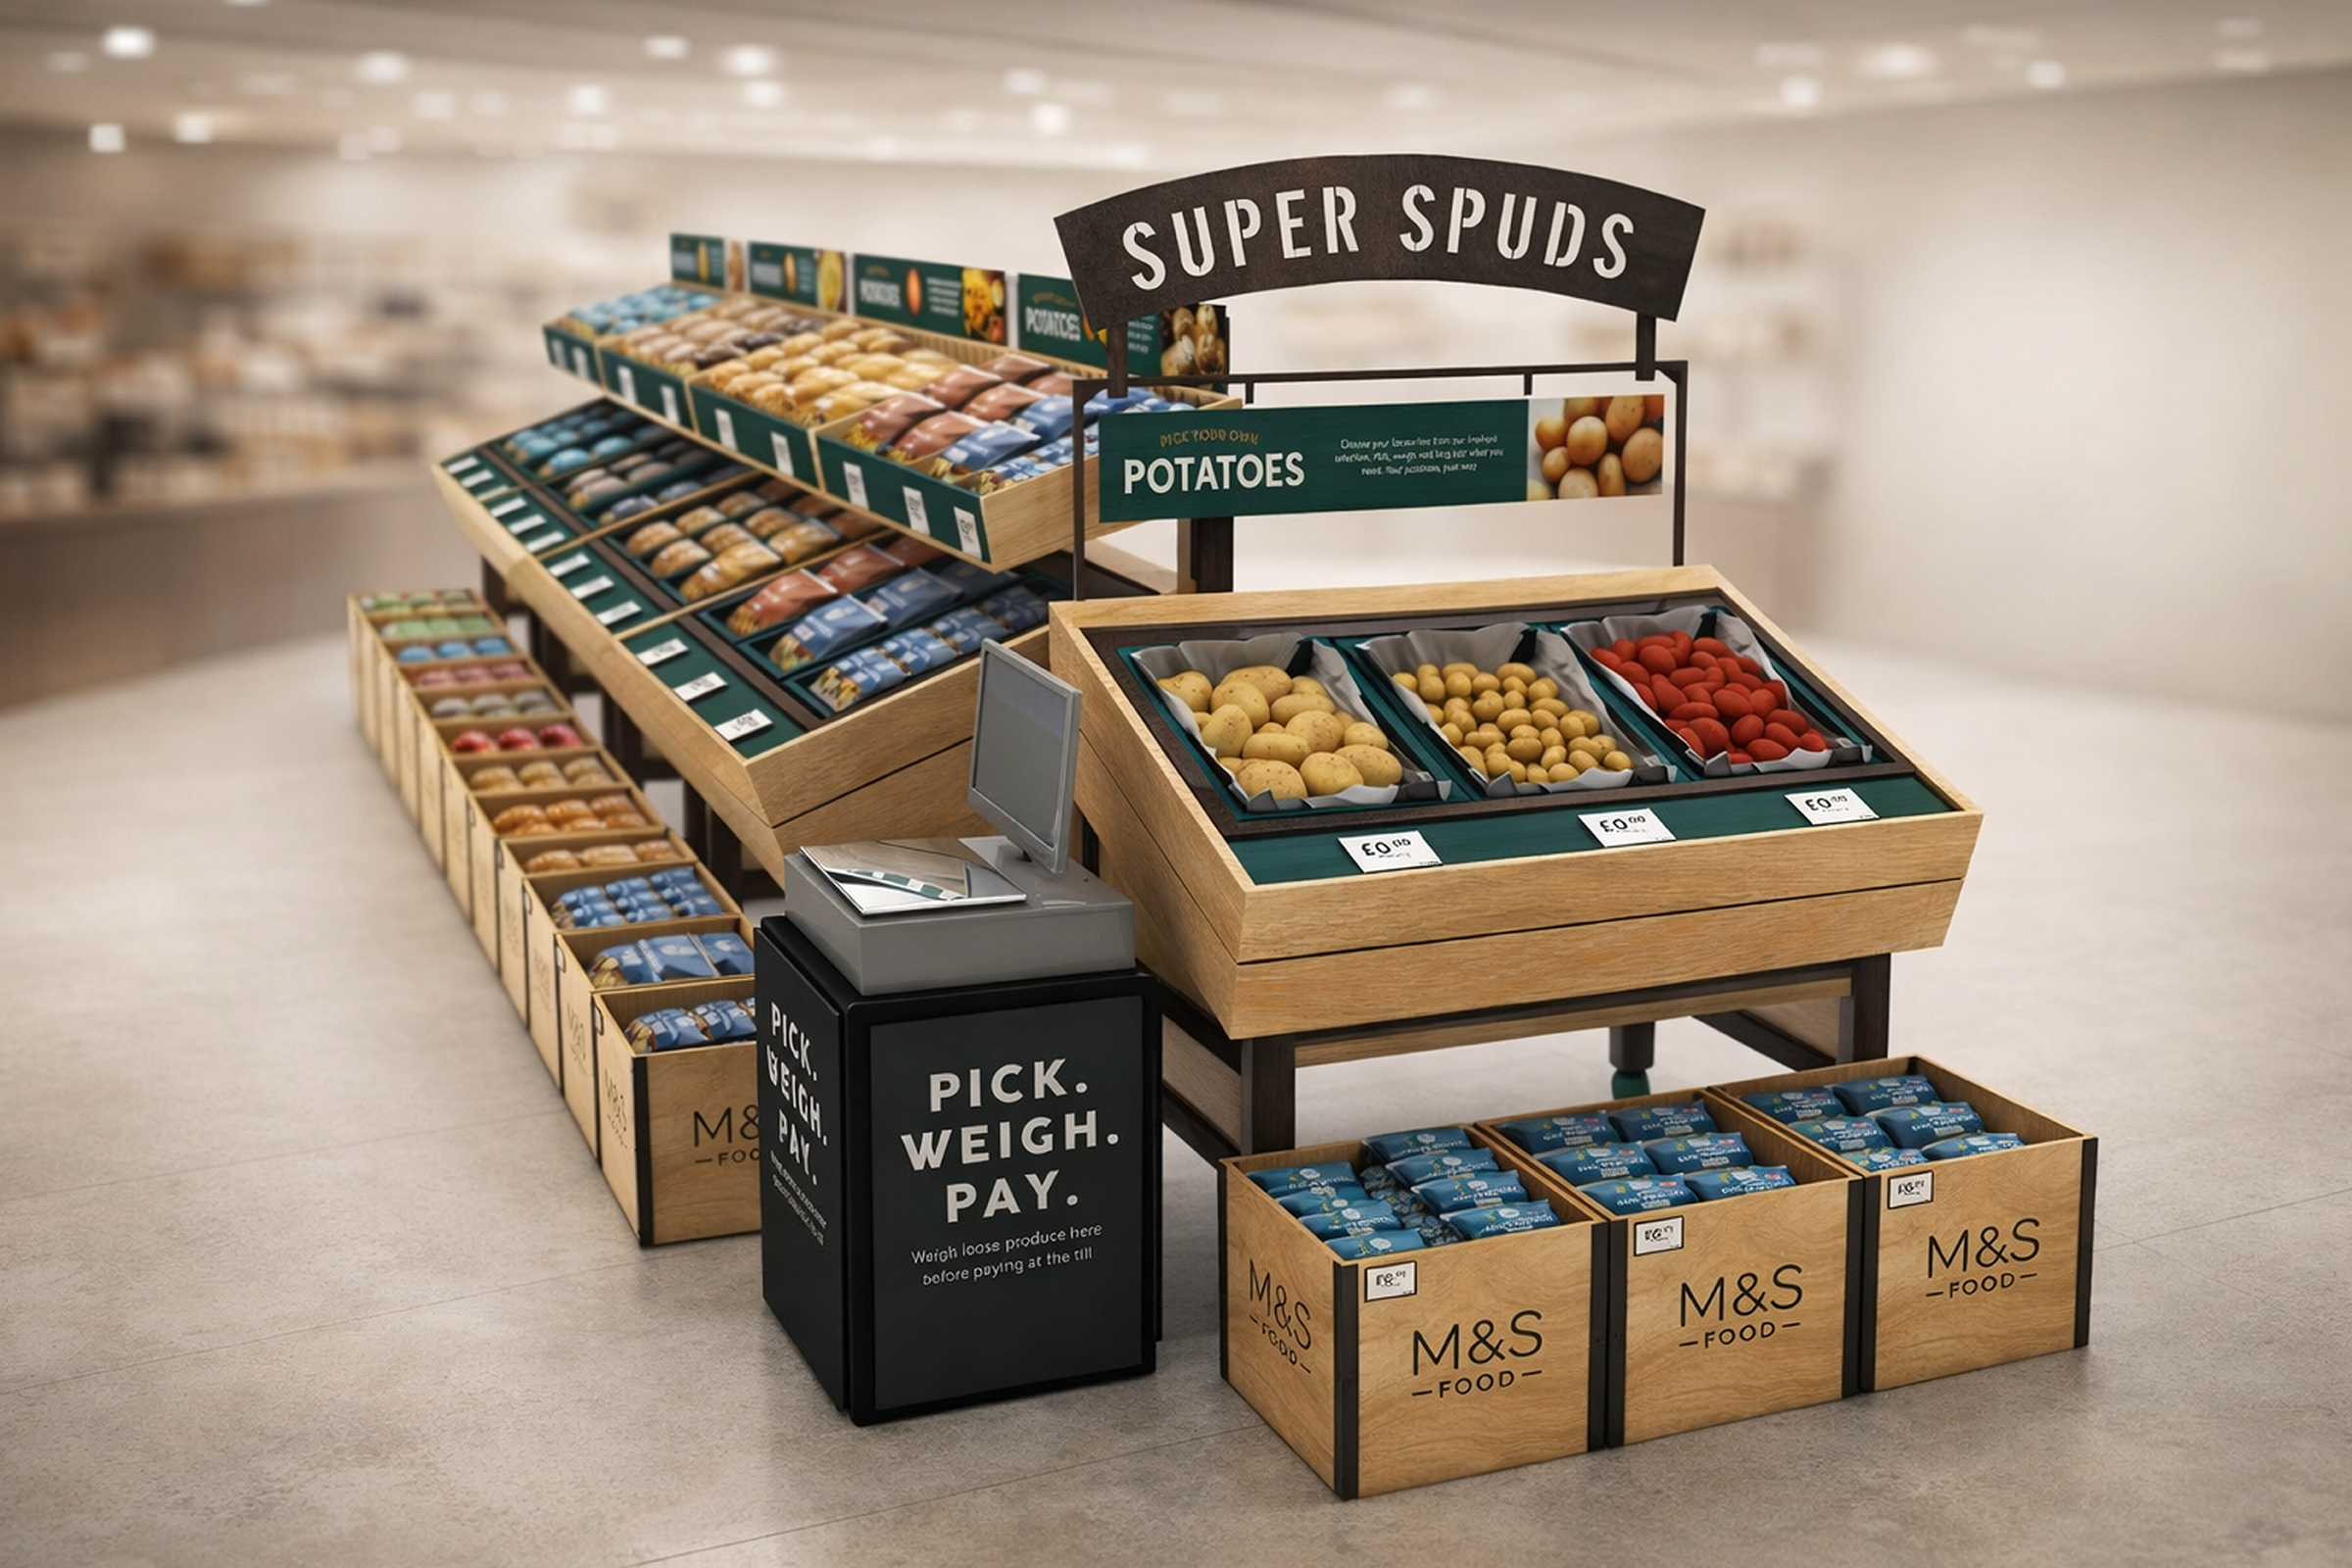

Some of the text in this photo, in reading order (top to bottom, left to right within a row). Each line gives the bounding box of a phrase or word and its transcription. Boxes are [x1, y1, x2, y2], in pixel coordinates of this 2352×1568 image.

[1121, 184, 1636, 291] SUPER SPUDS
[1124, 451, 1305, 494] POTATOES
[771, 1002, 818, 1082] PICK.
[929, 1058, 1089, 1113] PICK.
[693, 1104, 760, 1148] M&
[778, 1109, 818, 1186] PAY.
[901, 1109, 1120, 1172] WEIGH.
[718, 1148, 760, 1165] FOO
[946, 1169, 1079, 1224] PAY.
[910, 1224, 1103, 1265] Weigh loose produce here
[922, 1247, 1094, 1287] before paying at the till
[1928, 1218, 2040, 1279] M&S
[1250, 1258, 1311, 1350] M&S
[1680, 1263, 1803, 1327] M&S
[1950, 1272, 2015, 1298] FOOD
[1413, 1309, 1543, 1376] M&S
[1705, 1321, 1776, 1348] FOOD
[1439, 1370, 1515, 1398] FOOD
